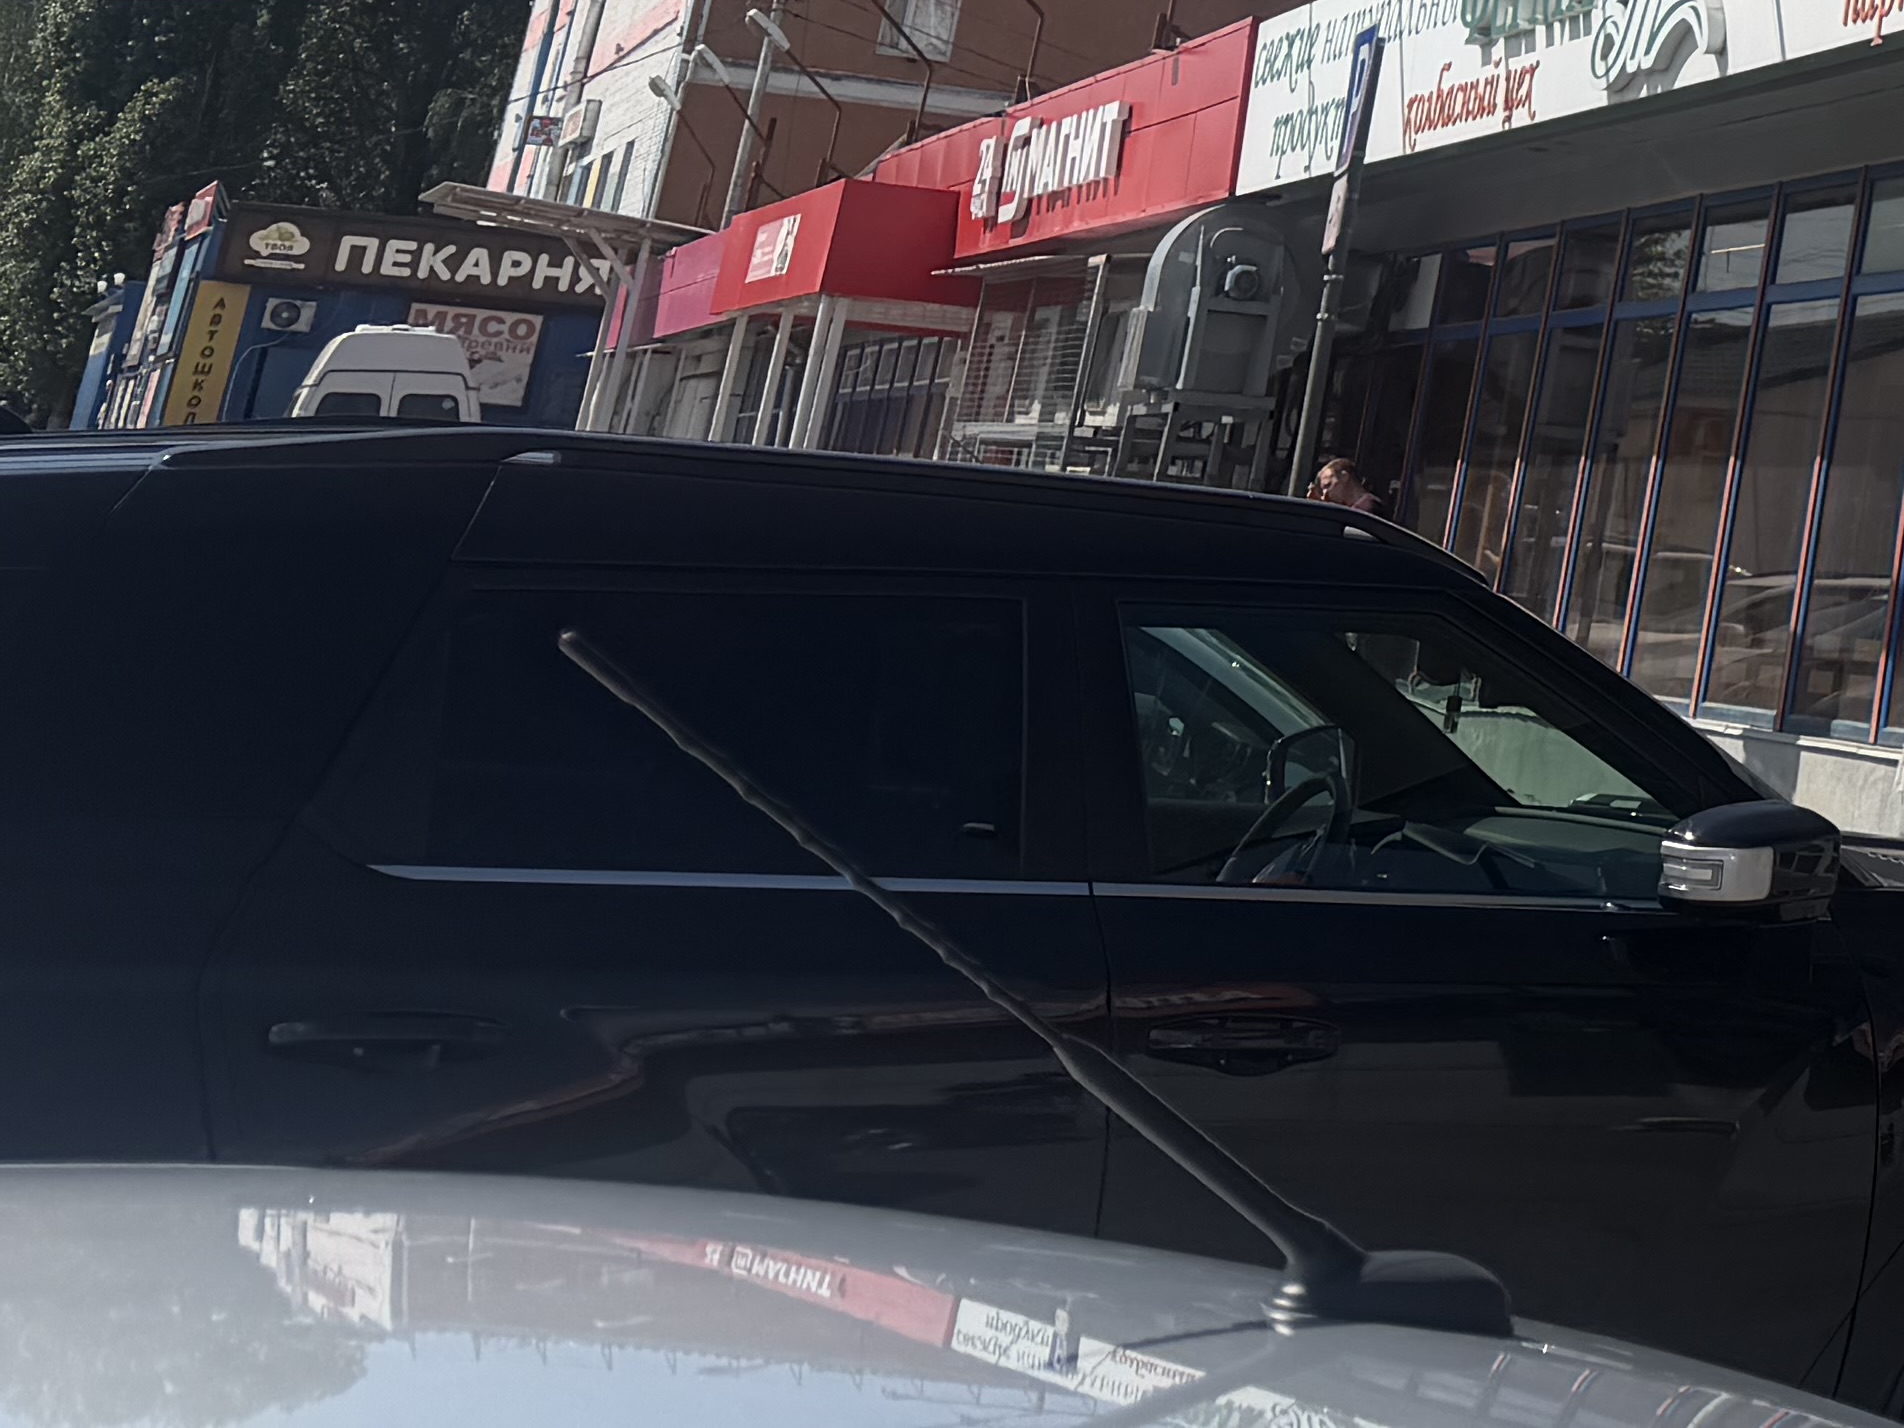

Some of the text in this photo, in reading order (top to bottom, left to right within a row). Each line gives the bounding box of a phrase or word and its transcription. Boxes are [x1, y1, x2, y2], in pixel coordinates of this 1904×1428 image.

[1254, 24, 1321, 94] свежие
[1403, 57, 1541, 153] колбасный цех
[1022, 100, 1122, 200] МАГНИТ
[1270, 80, 1346, 180] продукт
[334, 235, 612, 295] ПЕКАРНЯ
[183, 296, 226, 425] АВТОШКОЛ
[410, 308, 537, 341] МЯСО
